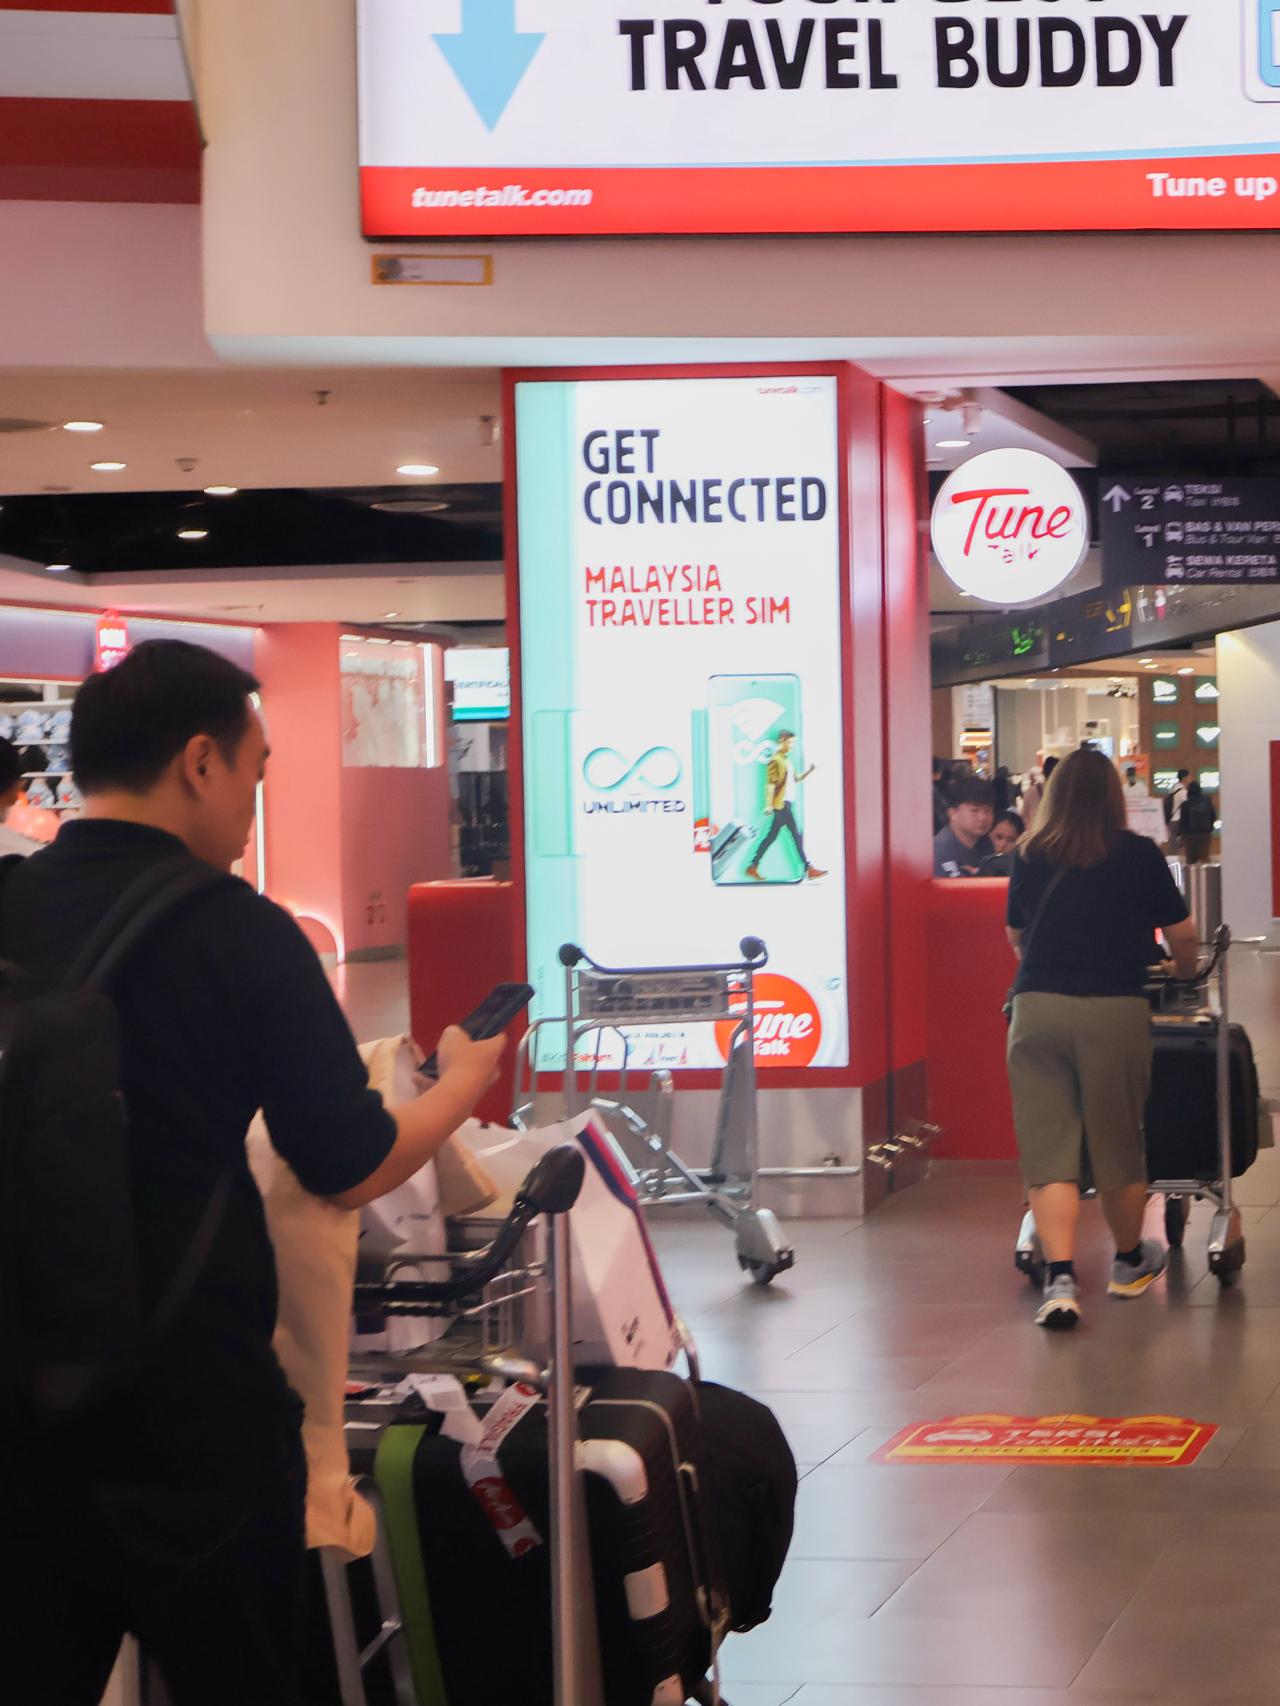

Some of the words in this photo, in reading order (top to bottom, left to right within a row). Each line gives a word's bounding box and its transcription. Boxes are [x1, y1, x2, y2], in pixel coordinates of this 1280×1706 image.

[618, 18, 898, 90] TRAVEL
[935, 14, 1188, 89] BUDDY
[411, 185, 593, 208] tunetalk.com
[1146, 172, 1227, 197] Tune
[1234, 175, 1277, 201] up
[583, 429, 660, 475] GET
[583, 476, 827, 525] CONNECTED
[1140, 496, 1155, 510] 2
[1184, 484, 1222, 495] TEKSI
[951, 488, 1071, 557] Tune
[1142, 533, 1153, 547] 1
[585, 564, 722, 593] MALAYSIA
[586, 598, 734, 626] TRAVELLER
[745, 597, 790, 624] SIM
[584, 800, 685, 814] UNLIMITED
